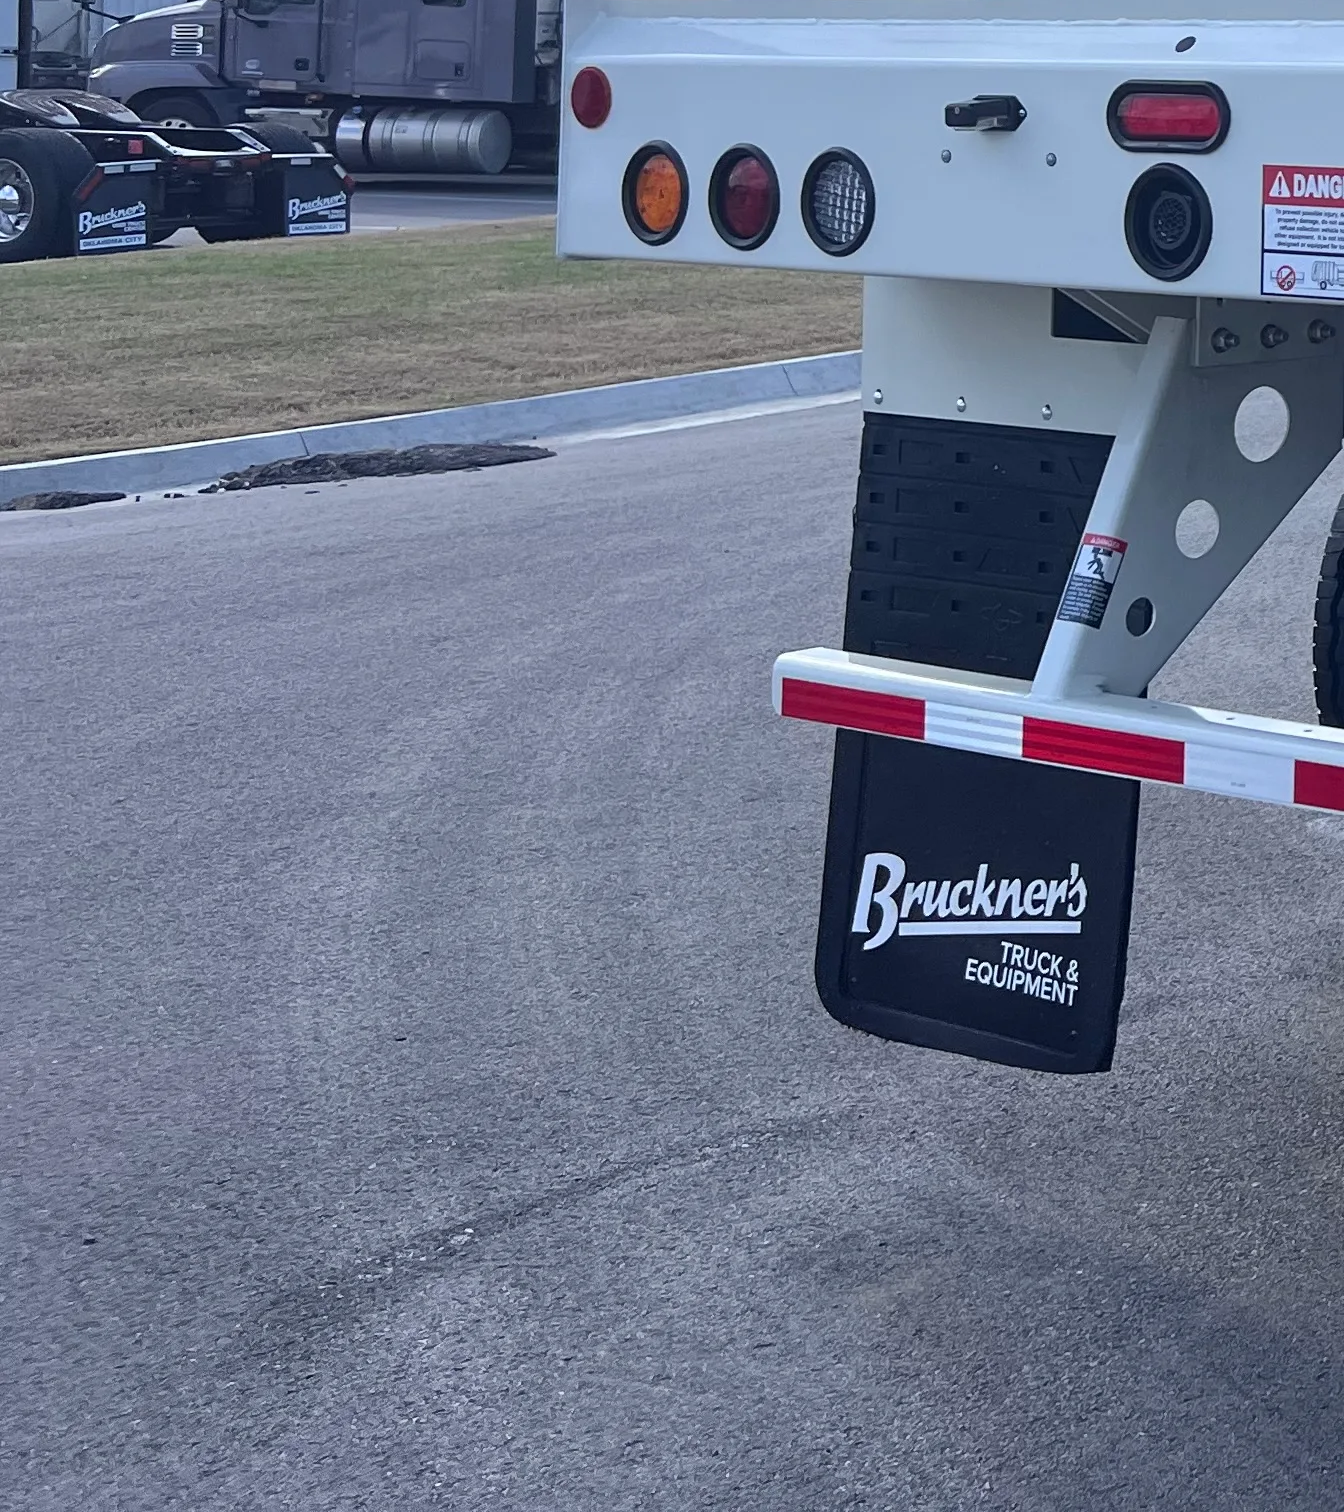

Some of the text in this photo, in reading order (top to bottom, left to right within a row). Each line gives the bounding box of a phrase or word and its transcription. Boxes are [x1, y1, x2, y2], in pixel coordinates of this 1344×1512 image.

[852, 852, 1087, 951] Bruckner's
[965, 958, 1079, 1006] EQUIPMENT
[1000, 941, 1079, 982] TRUCK &
